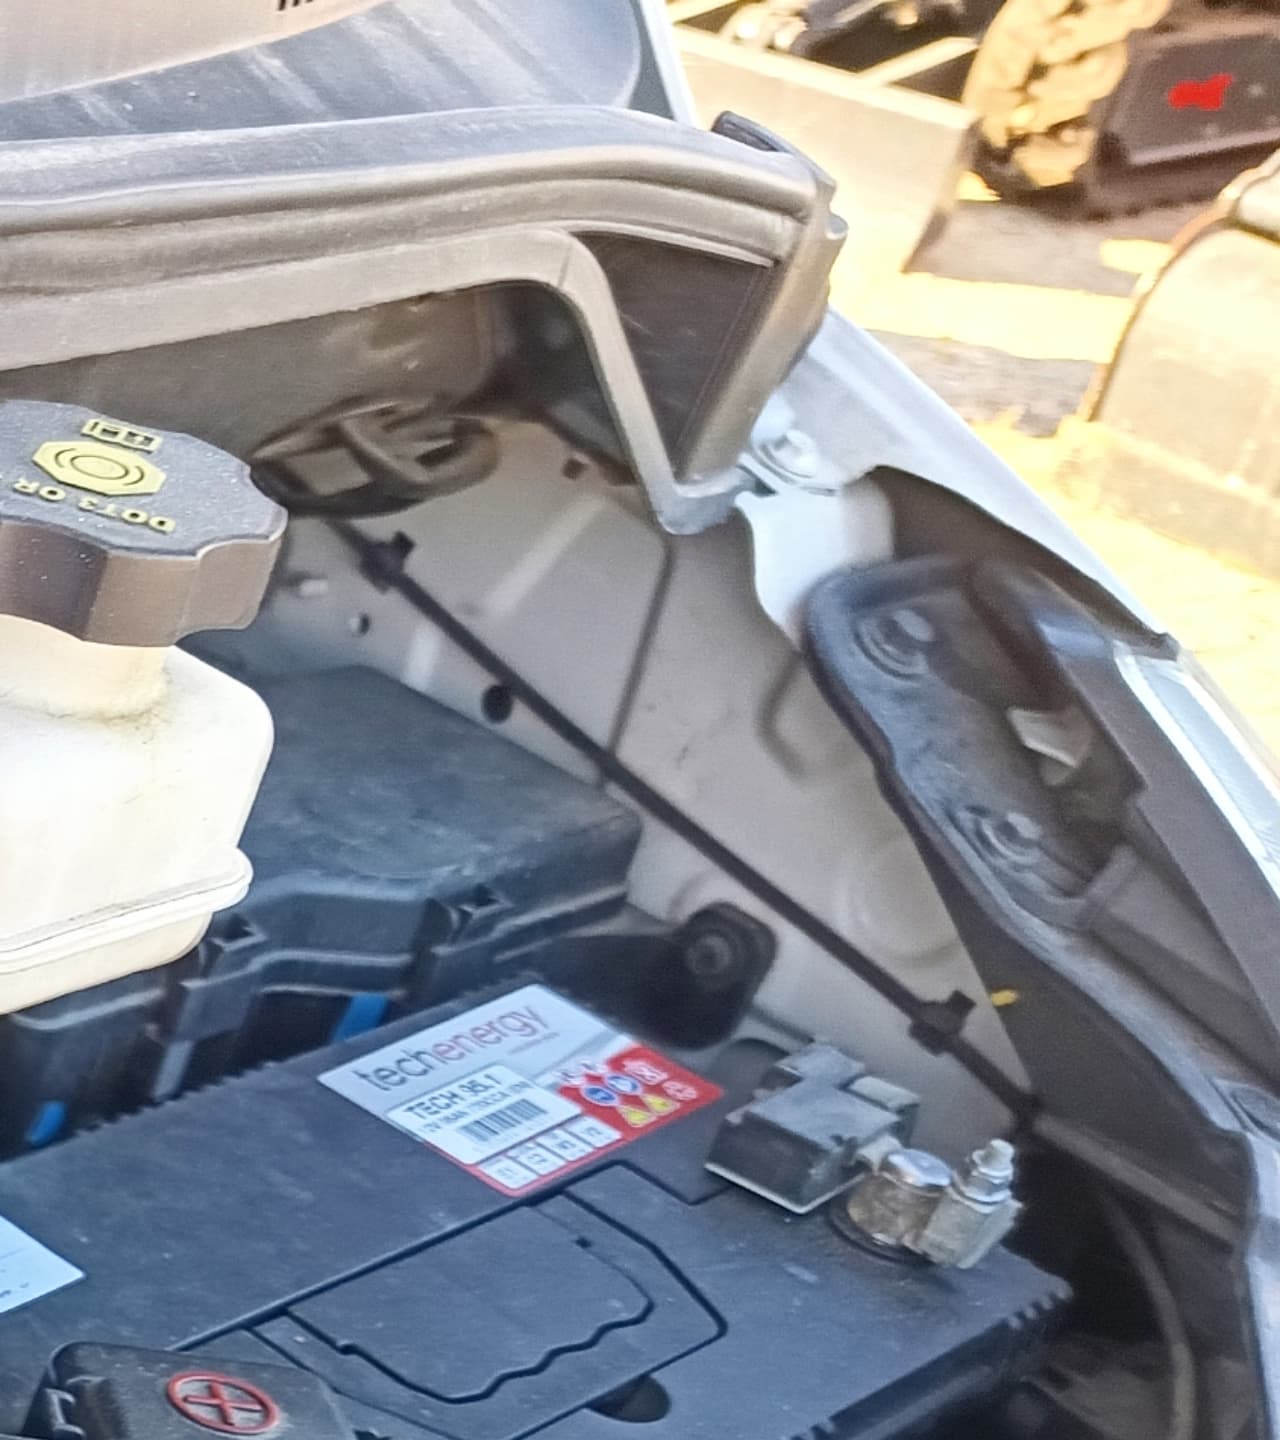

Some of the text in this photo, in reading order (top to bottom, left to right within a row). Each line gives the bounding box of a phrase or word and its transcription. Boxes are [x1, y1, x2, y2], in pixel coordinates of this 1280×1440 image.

[13, 477, 66, 502] OR
[78, 497, 176, 534] DOT3
[353, 1006, 549, 1091] techenergy
[403, 1090, 461, 1119] TECH
